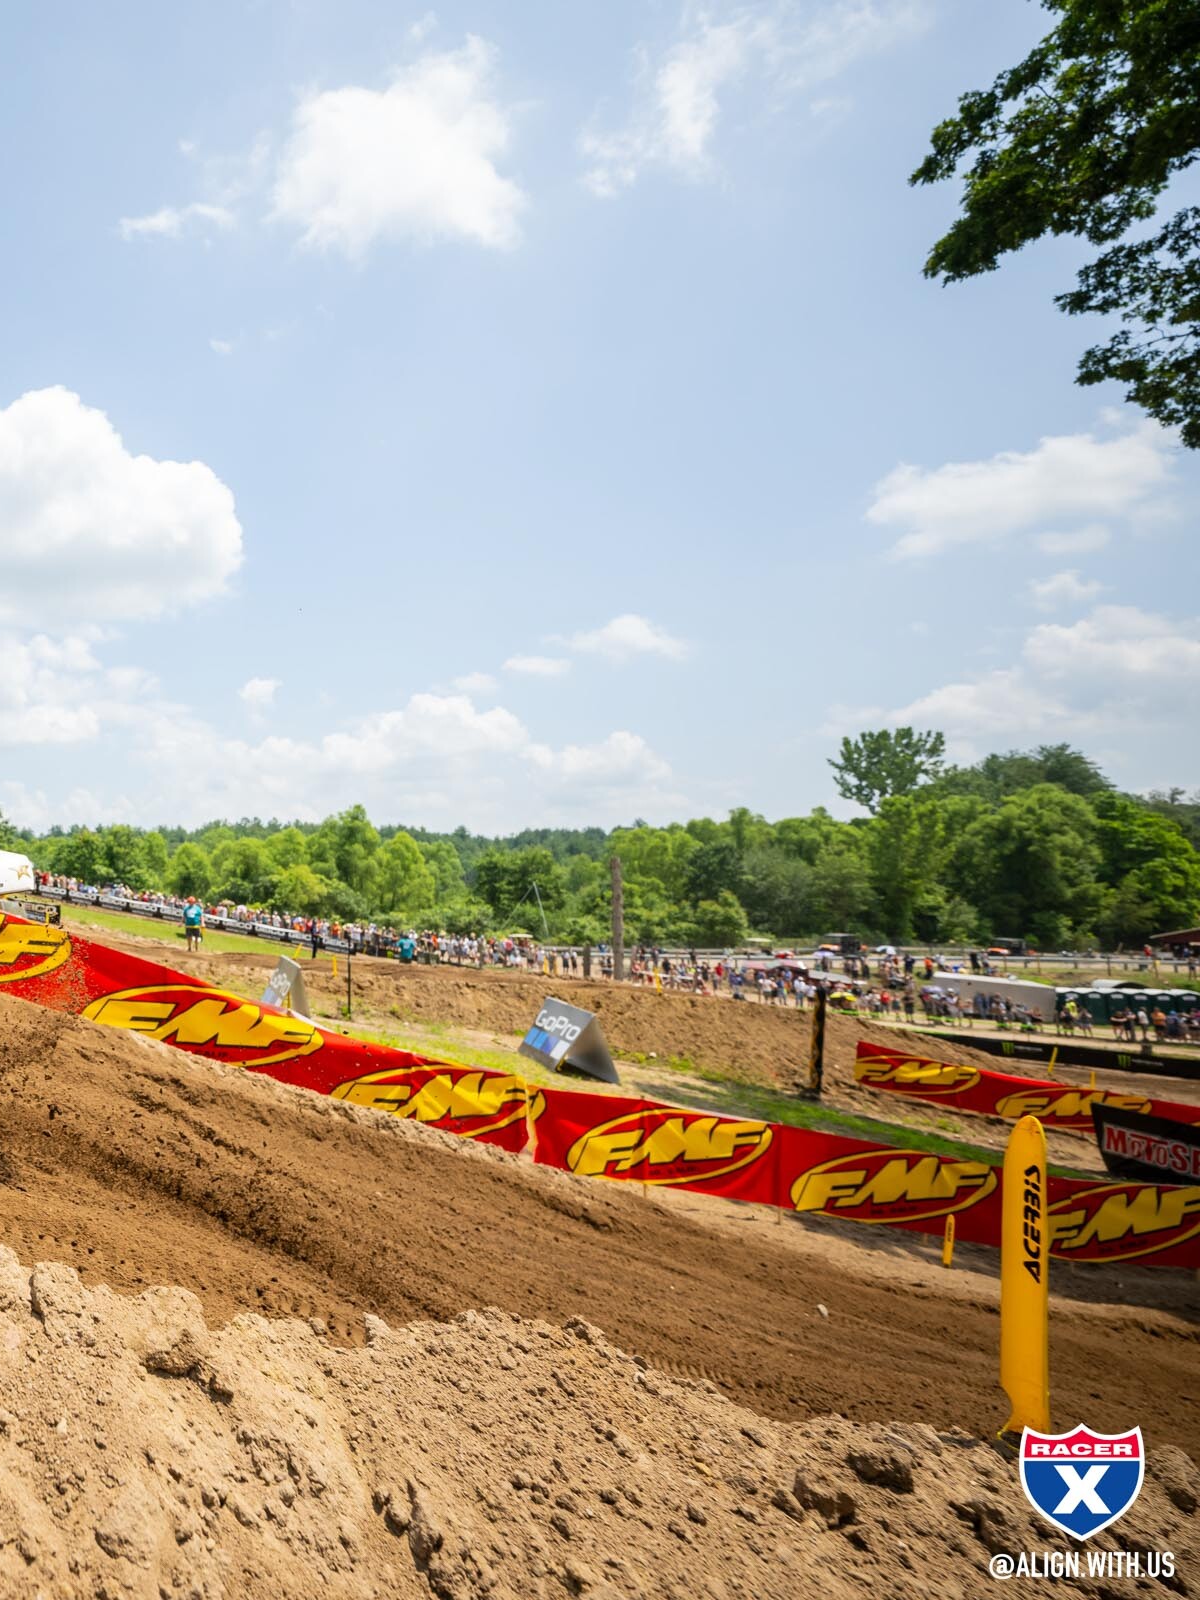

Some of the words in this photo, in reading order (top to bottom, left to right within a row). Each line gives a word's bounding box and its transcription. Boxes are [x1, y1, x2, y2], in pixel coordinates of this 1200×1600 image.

[92, 998, 316, 1048] FMF
[535, 1009, 582, 1041] GoPro
[341, 1071, 540, 1122] FMF
[854, 1061, 978, 1085] FMF
[573, 1117, 768, 1176] FMF
[795, 1156, 991, 1212] FMF
[1023, 1164, 1041, 1284] ACERBIS
[1048, 1185, 1200, 1250] FMF
